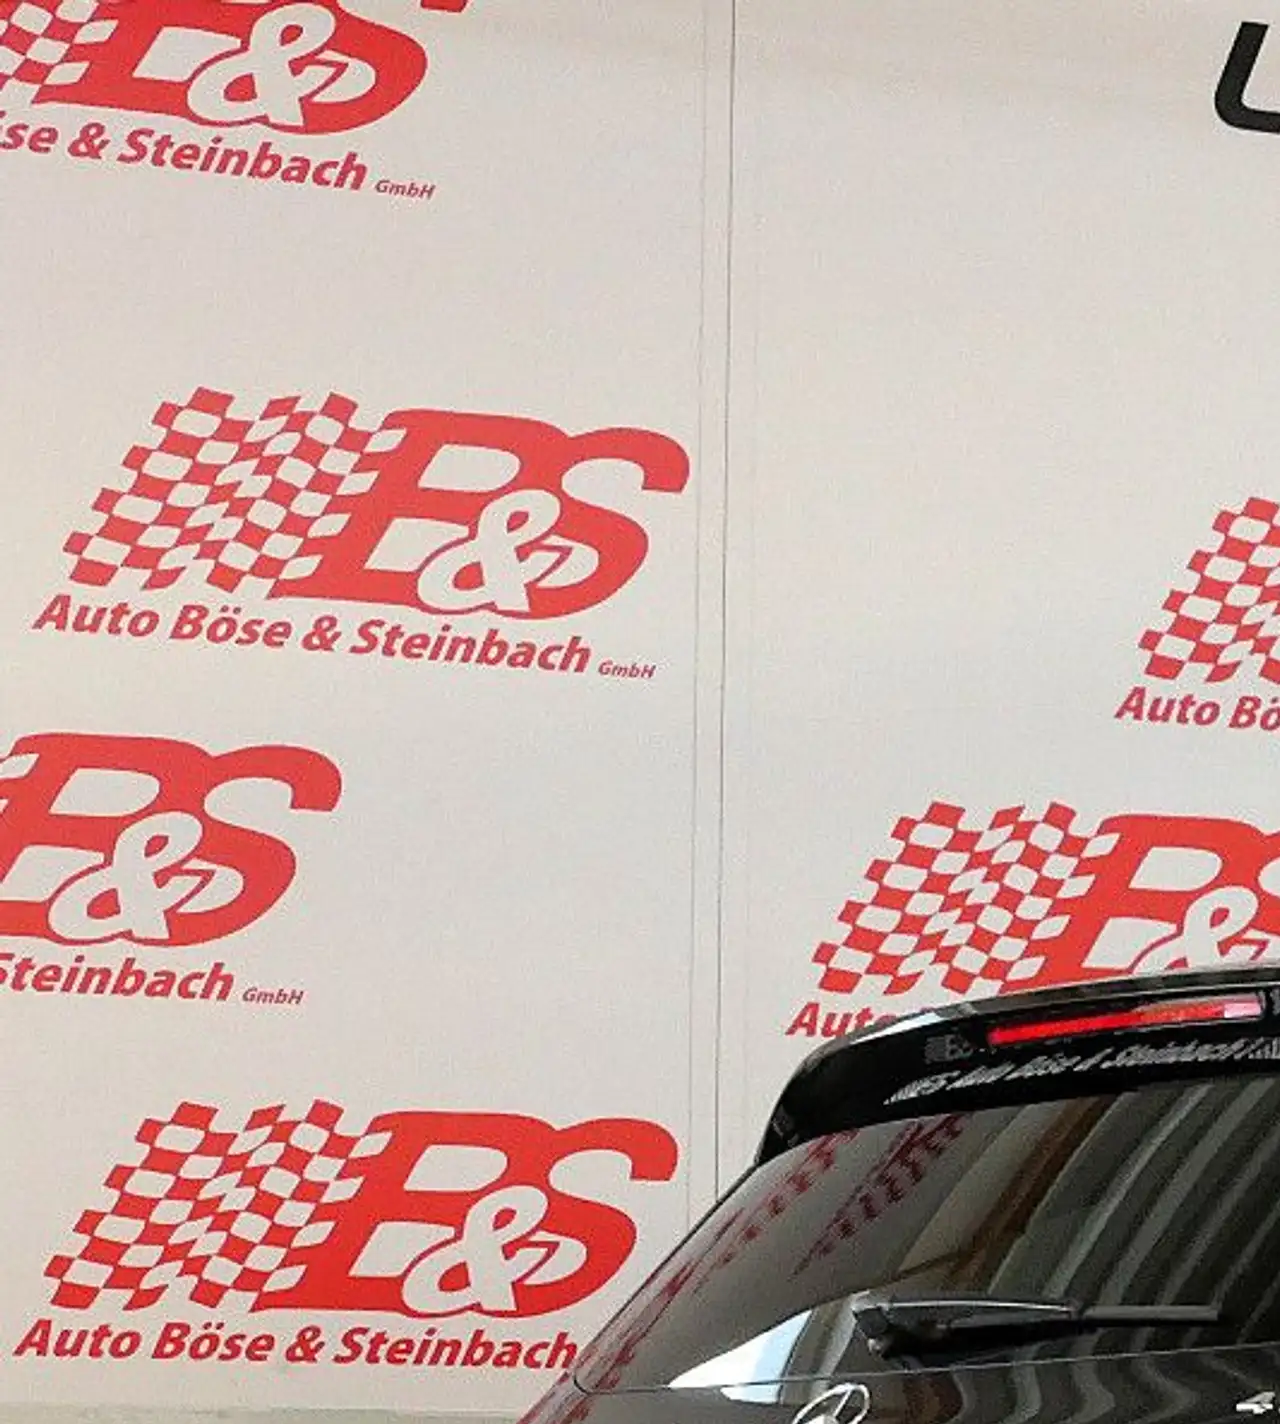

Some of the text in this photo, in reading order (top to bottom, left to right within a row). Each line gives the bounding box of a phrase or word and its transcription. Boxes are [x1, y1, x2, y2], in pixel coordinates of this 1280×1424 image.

[0, 111, 438, 201] se & Steinbach GmbH
[271, 409, 690, 620] B&S
[33, 593, 655, 679] Auto Böse & Steinbach GmbH
[1116, 686, 1220, 727] Auto
[0, 733, 342, 945] B&S
[240, 985, 305, 1006] GmbH
[251, 1111, 679, 1319] B&S
[15, 1318, 578, 1370] Auto Böse & Steinbach
